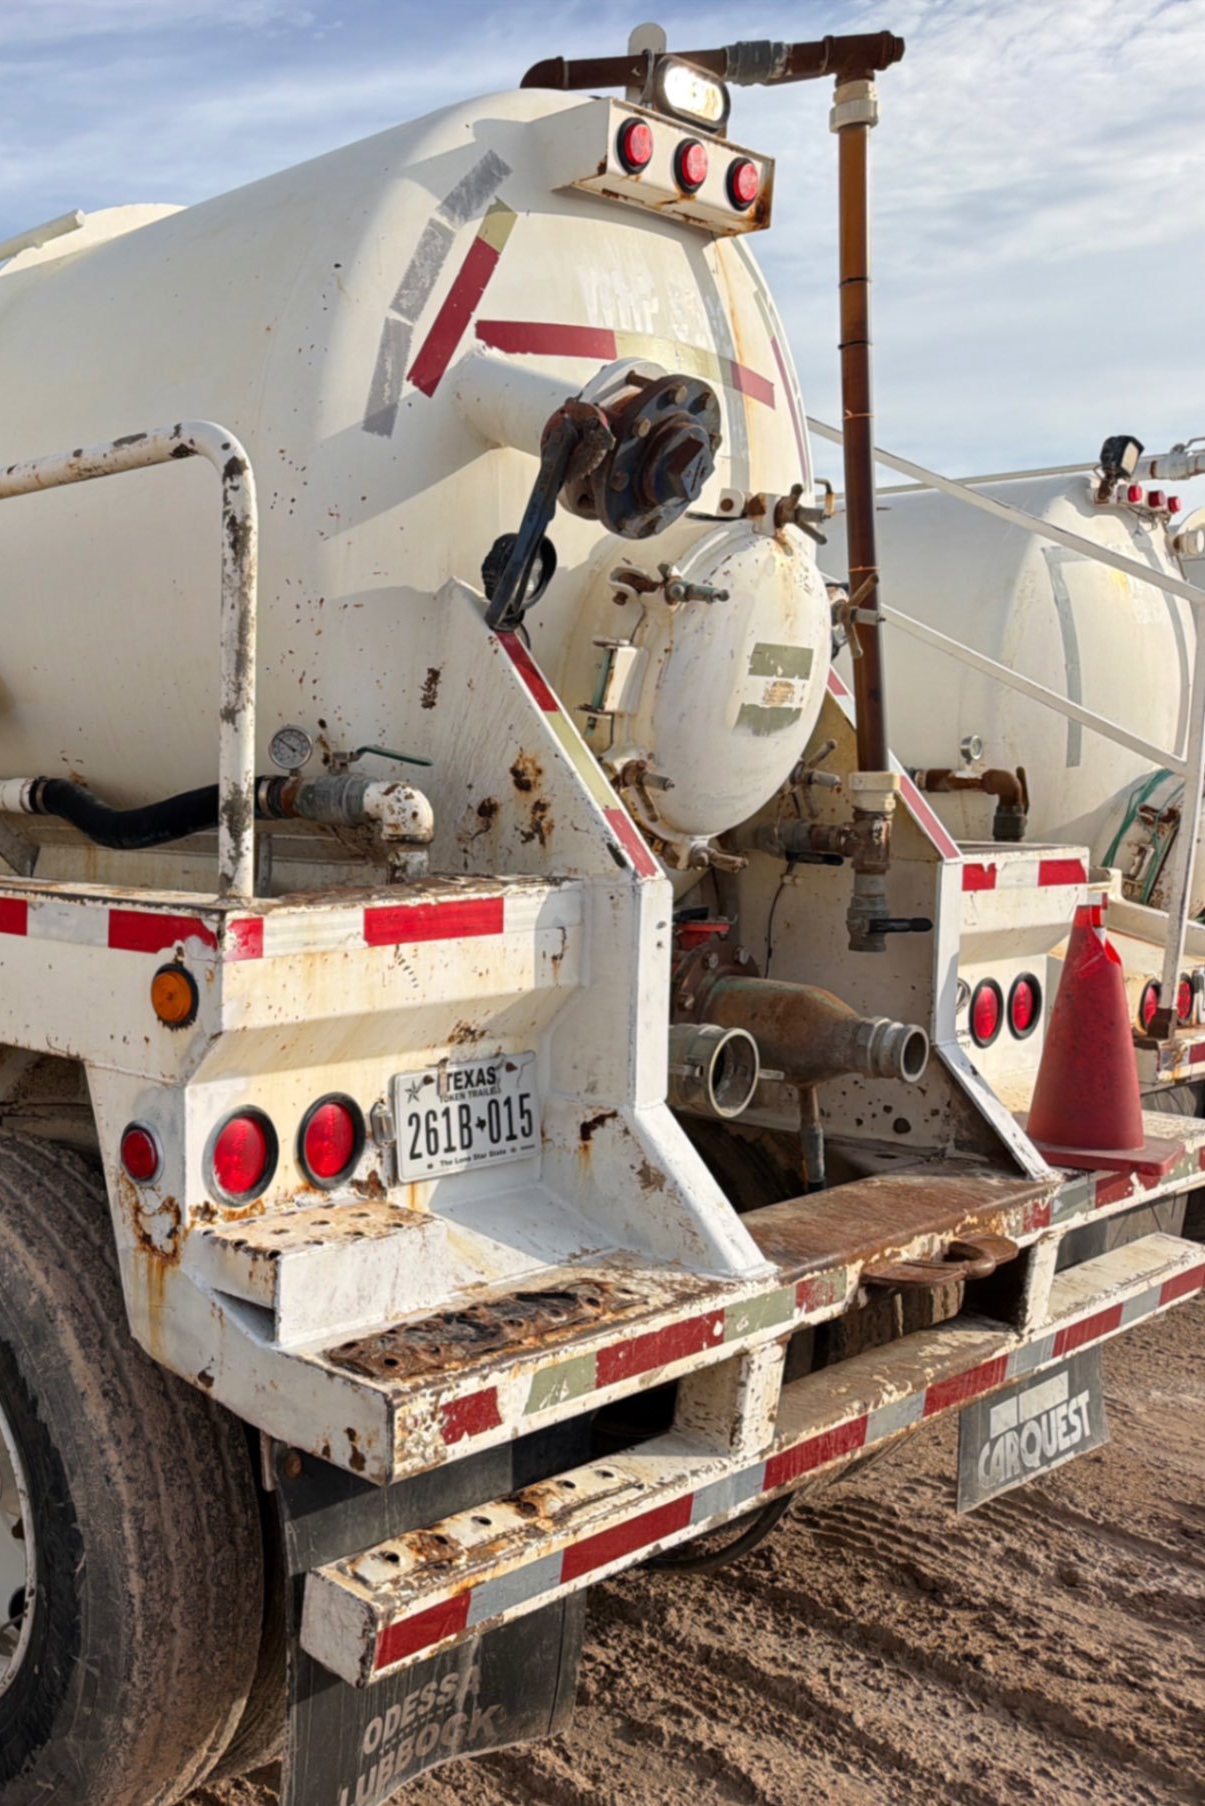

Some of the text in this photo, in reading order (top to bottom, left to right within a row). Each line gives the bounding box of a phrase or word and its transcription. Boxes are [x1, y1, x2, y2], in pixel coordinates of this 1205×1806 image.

[445, 1066, 497, 1093] TEXAS
[978, 1389, 1091, 1489] CARQUEST
[362, 1666, 481, 1754] ODESSA
